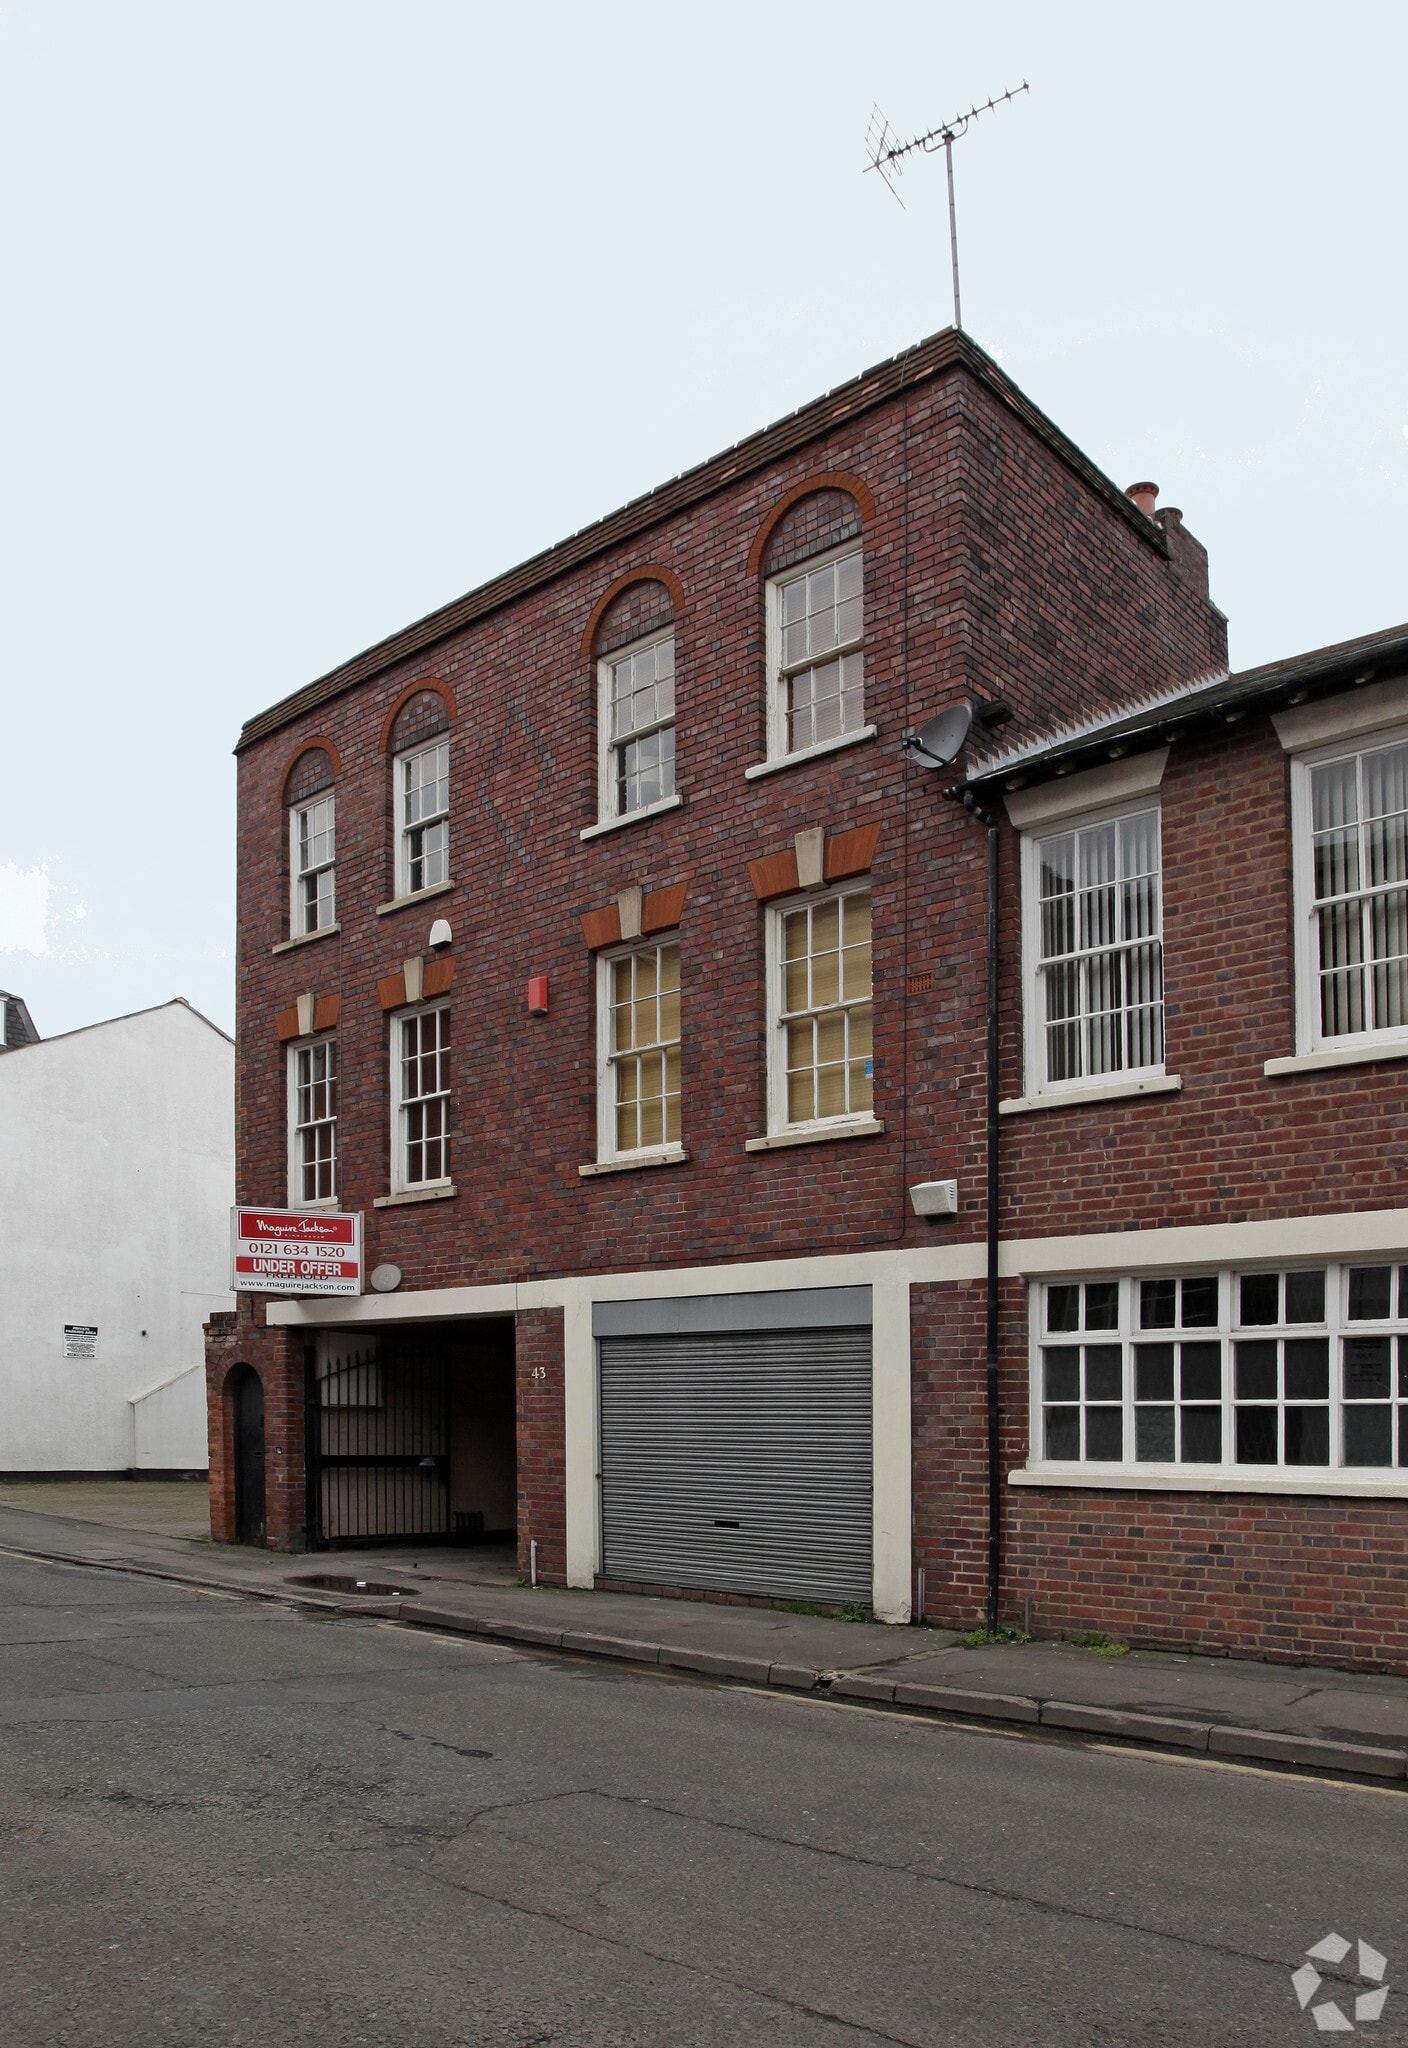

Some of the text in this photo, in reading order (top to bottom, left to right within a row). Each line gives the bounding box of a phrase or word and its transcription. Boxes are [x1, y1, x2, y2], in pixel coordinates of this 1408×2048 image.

[256, 1219, 335, 1236] Maguire Jackson
[249, 1242, 345, 1258] 0121 634 1520
[252, 1258, 342, 1276] UNDER OFFER
[240, 1280, 355, 1291] www.maguirejackson.com
[531, 1366, 546, 1379] 43
